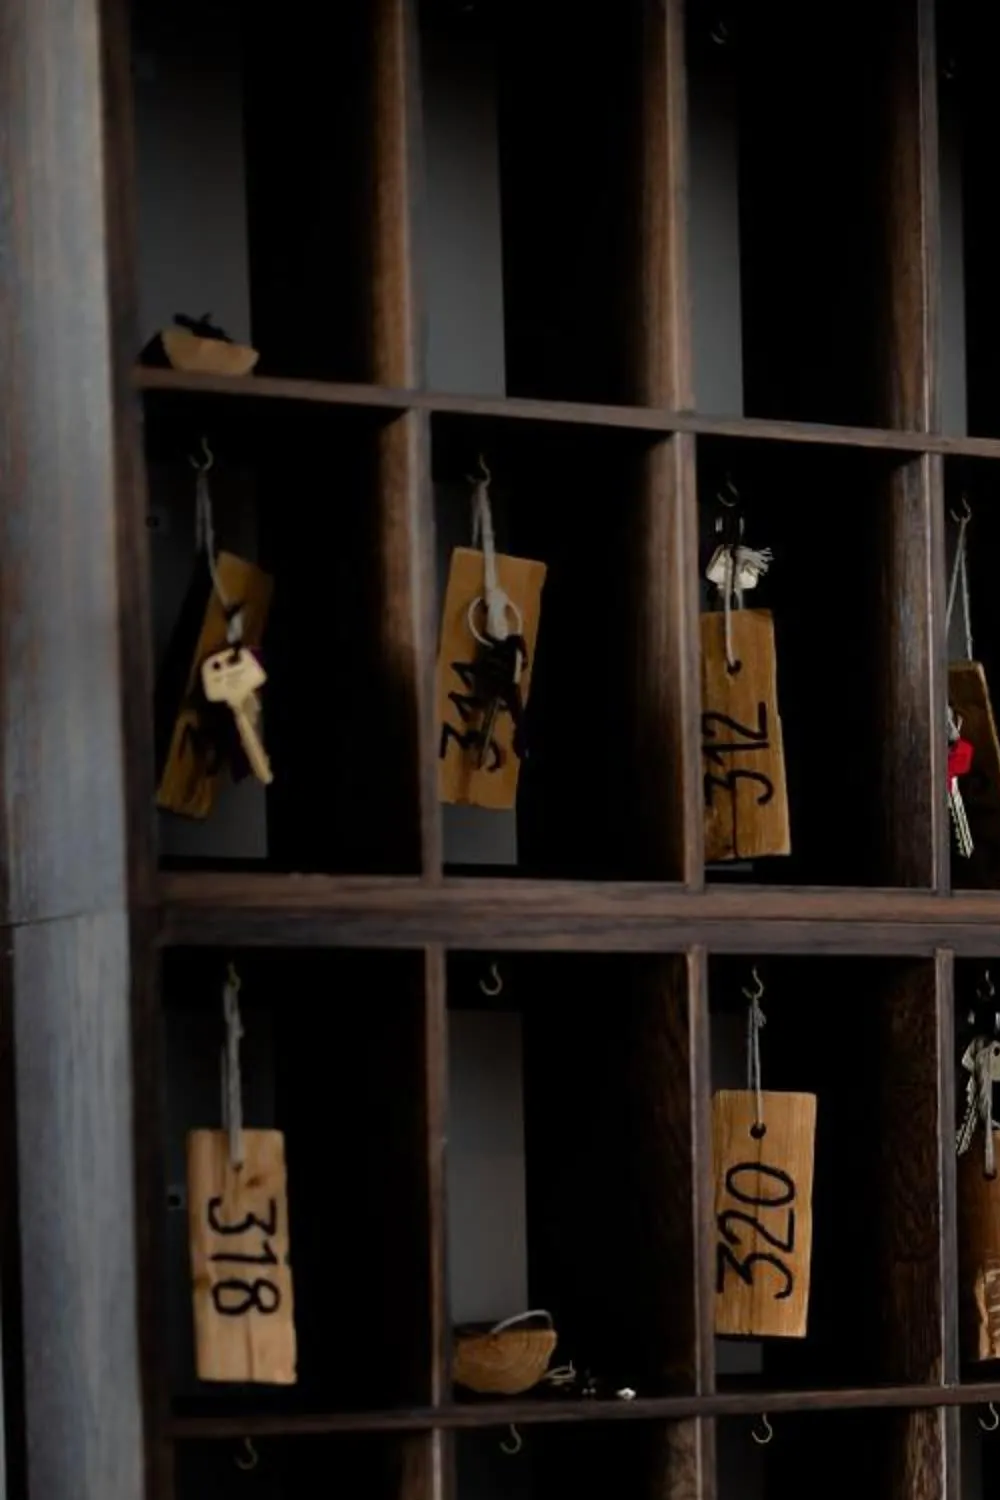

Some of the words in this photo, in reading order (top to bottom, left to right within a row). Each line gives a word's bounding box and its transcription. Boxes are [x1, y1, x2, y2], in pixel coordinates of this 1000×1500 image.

[702, 701, 774, 806] 312
[209, 1197, 280, 1315] 318
[716, 1161, 794, 1299] 320
